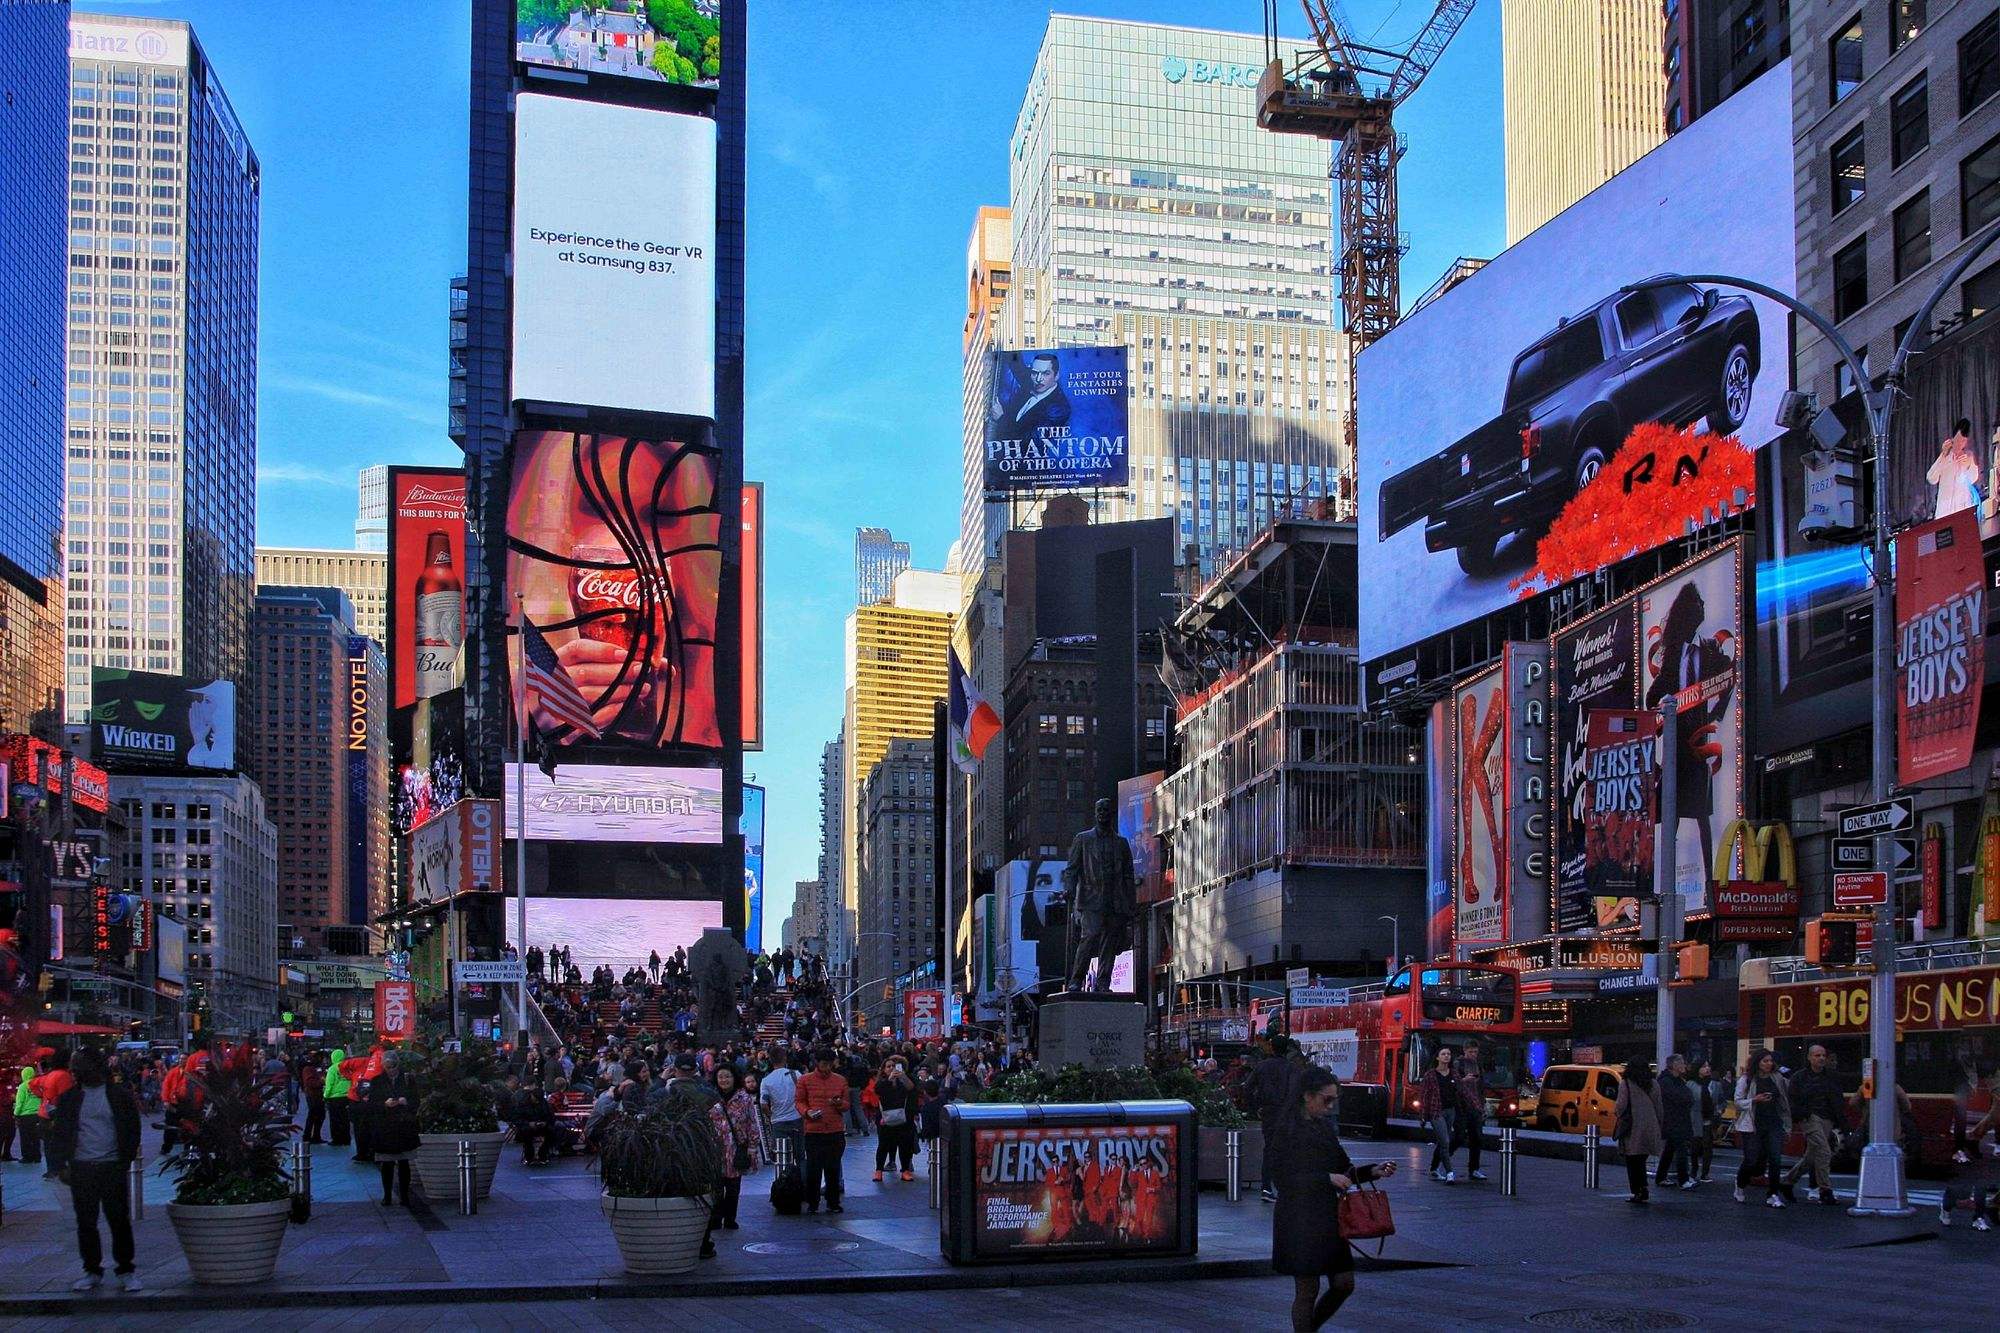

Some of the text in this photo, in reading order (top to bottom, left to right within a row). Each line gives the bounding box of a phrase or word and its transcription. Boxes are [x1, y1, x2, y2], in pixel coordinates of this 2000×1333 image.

[72, 30, 128, 52] lianz
[1192, 60, 1259, 89] BARC
[530, 228, 703, 259] Experience the Gear VR
[558, 251, 676, 274] at Samsung 837.
[1093, 371, 1121, 379] YOUR
[1068, 380, 1123, 388] FANTASIES
[1038, 427, 1071, 438] THE
[987, 436, 1124, 461] PHANTOM
[999, 457, 1112, 472] OF THE OPERA
[399, 508, 417, 517] THIS
[419, 509, 442, 519] BUD'S
[444, 511, 459, 519] FOR
[1897, 589, 1982, 668] JERSEY
[1907, 646, 1967, 708] BOYS
[350, 649, 366, 749] NOVOTEL
[1525, 661, 1543, 877] PALACE
[1587, 741, 1655, 781] JERSEY
[1594, 774, 1643, 812] BOYS
[577, 795, 694, 815] HYUNDAI
[1848, 811, 1890, 829] ONE WAY
[1842, 847, 1864, 860] ONE
[1846, 875, 1874, 883] STANDING
[1719, 892, 1798, 903] McDonald's
[1507, 949, 1519, 957] THE
[1612, 943, 1631, 951] THE
[1562, 952, 1643, 964] ILLUSIONI
[1600, 976, 1634, 990] CHANGE
[1456, 1006, 1501, 1020] CHARTER
[1818, 988, 1869, 1027] BIG
[914, 995, 937, 1039] tkts
[981, 1135, 1169, 1184] JERSEY BOYS
[986, 1204, 1032, 1213] BROADWAY
[986, 1212, 1048, 1221] PERFORMANCE
[986, 1220, 1025, 1229] JANUARY
